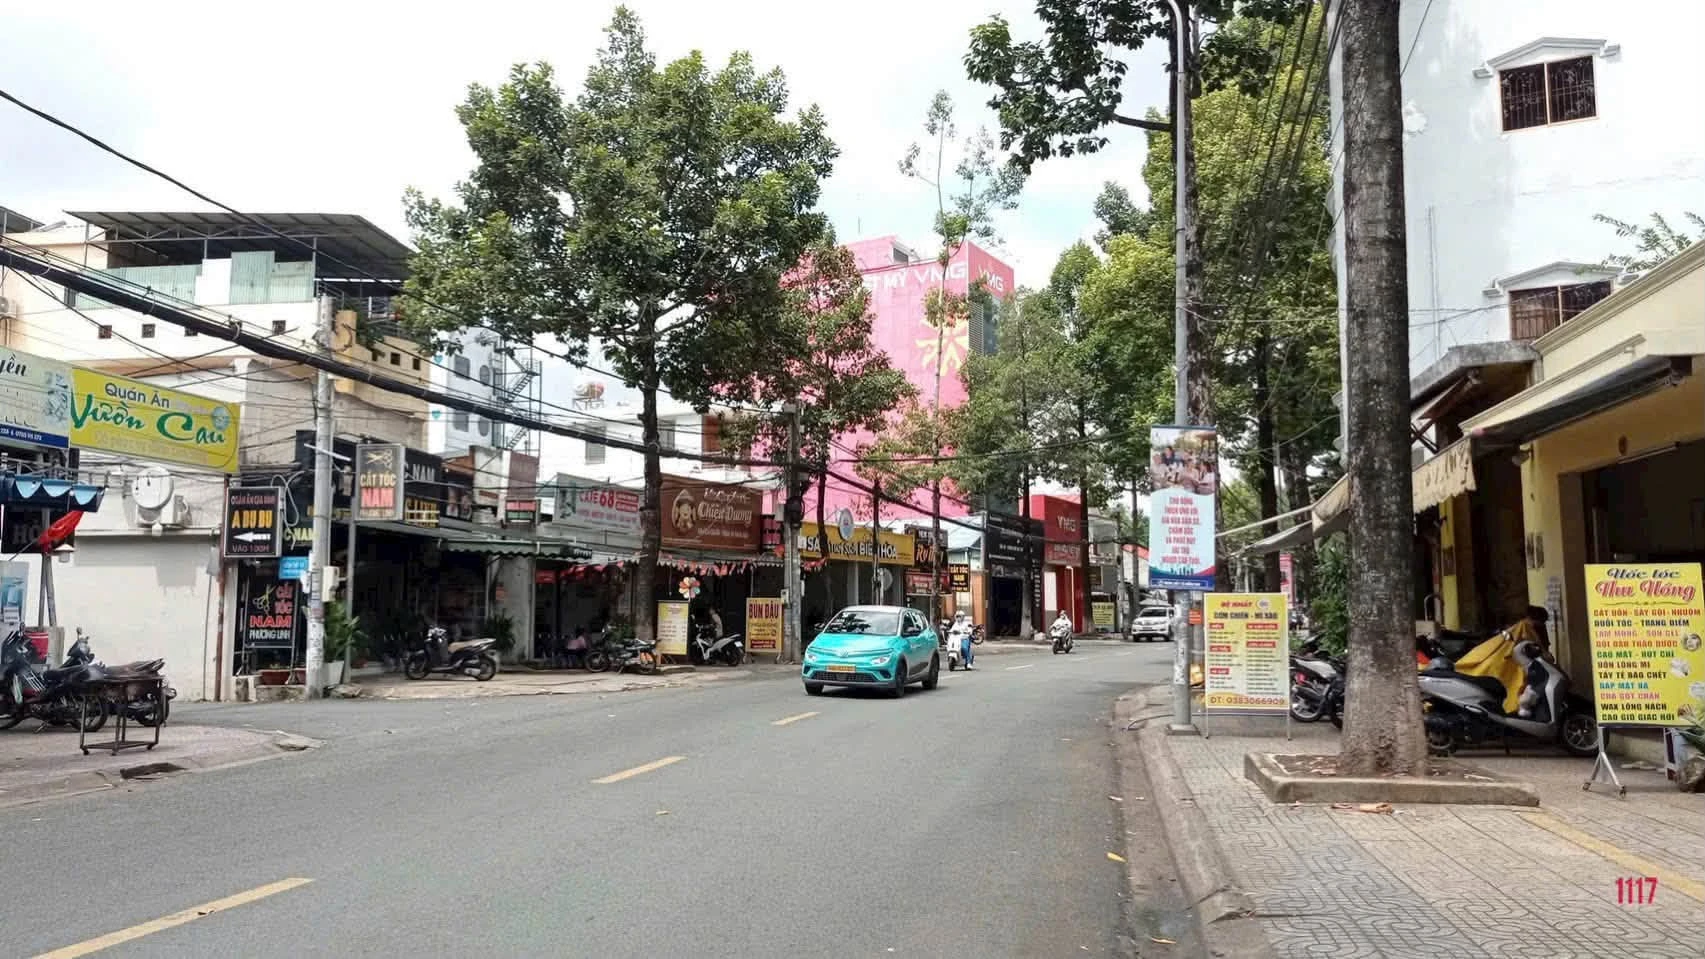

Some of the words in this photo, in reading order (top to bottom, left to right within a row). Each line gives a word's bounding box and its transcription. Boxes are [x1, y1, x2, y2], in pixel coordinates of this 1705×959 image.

[884, 268, 907, 288] MY
[914, 262, 967, 283] VMG
[105, 382, 146, 404] Quán
[151, 391, 170, 409] Ăn
[71, 391, 145, 430] Vườn
[156, 411, 225, 444] Cau
[360, 470, 376, 487] CẮT
[380, 471, 397, 487] TÓC
[412, 463, 434, 482] NAM
[361, 487, 393, 508] NAM
[600, 489, 615, 508] 68
[232, 509, 241, 529] A
[1057, 515, 1076, 532] VMG
[1652, 568, 1680, 579] tóc
[1640, 579, 1696, 602] Hồng
[749, 601, 763, 619] BÚN
[765, 600, 779, 622] ĐẬU
[250, 615, 292, 628] NAM
[1617, 618, 1632, 627] TÓC
[1641, 619, 1666, 627] TRANG
[1601, 703, 1618, 711] WAX
[1621, 703, 1642, 711] LÔNG
